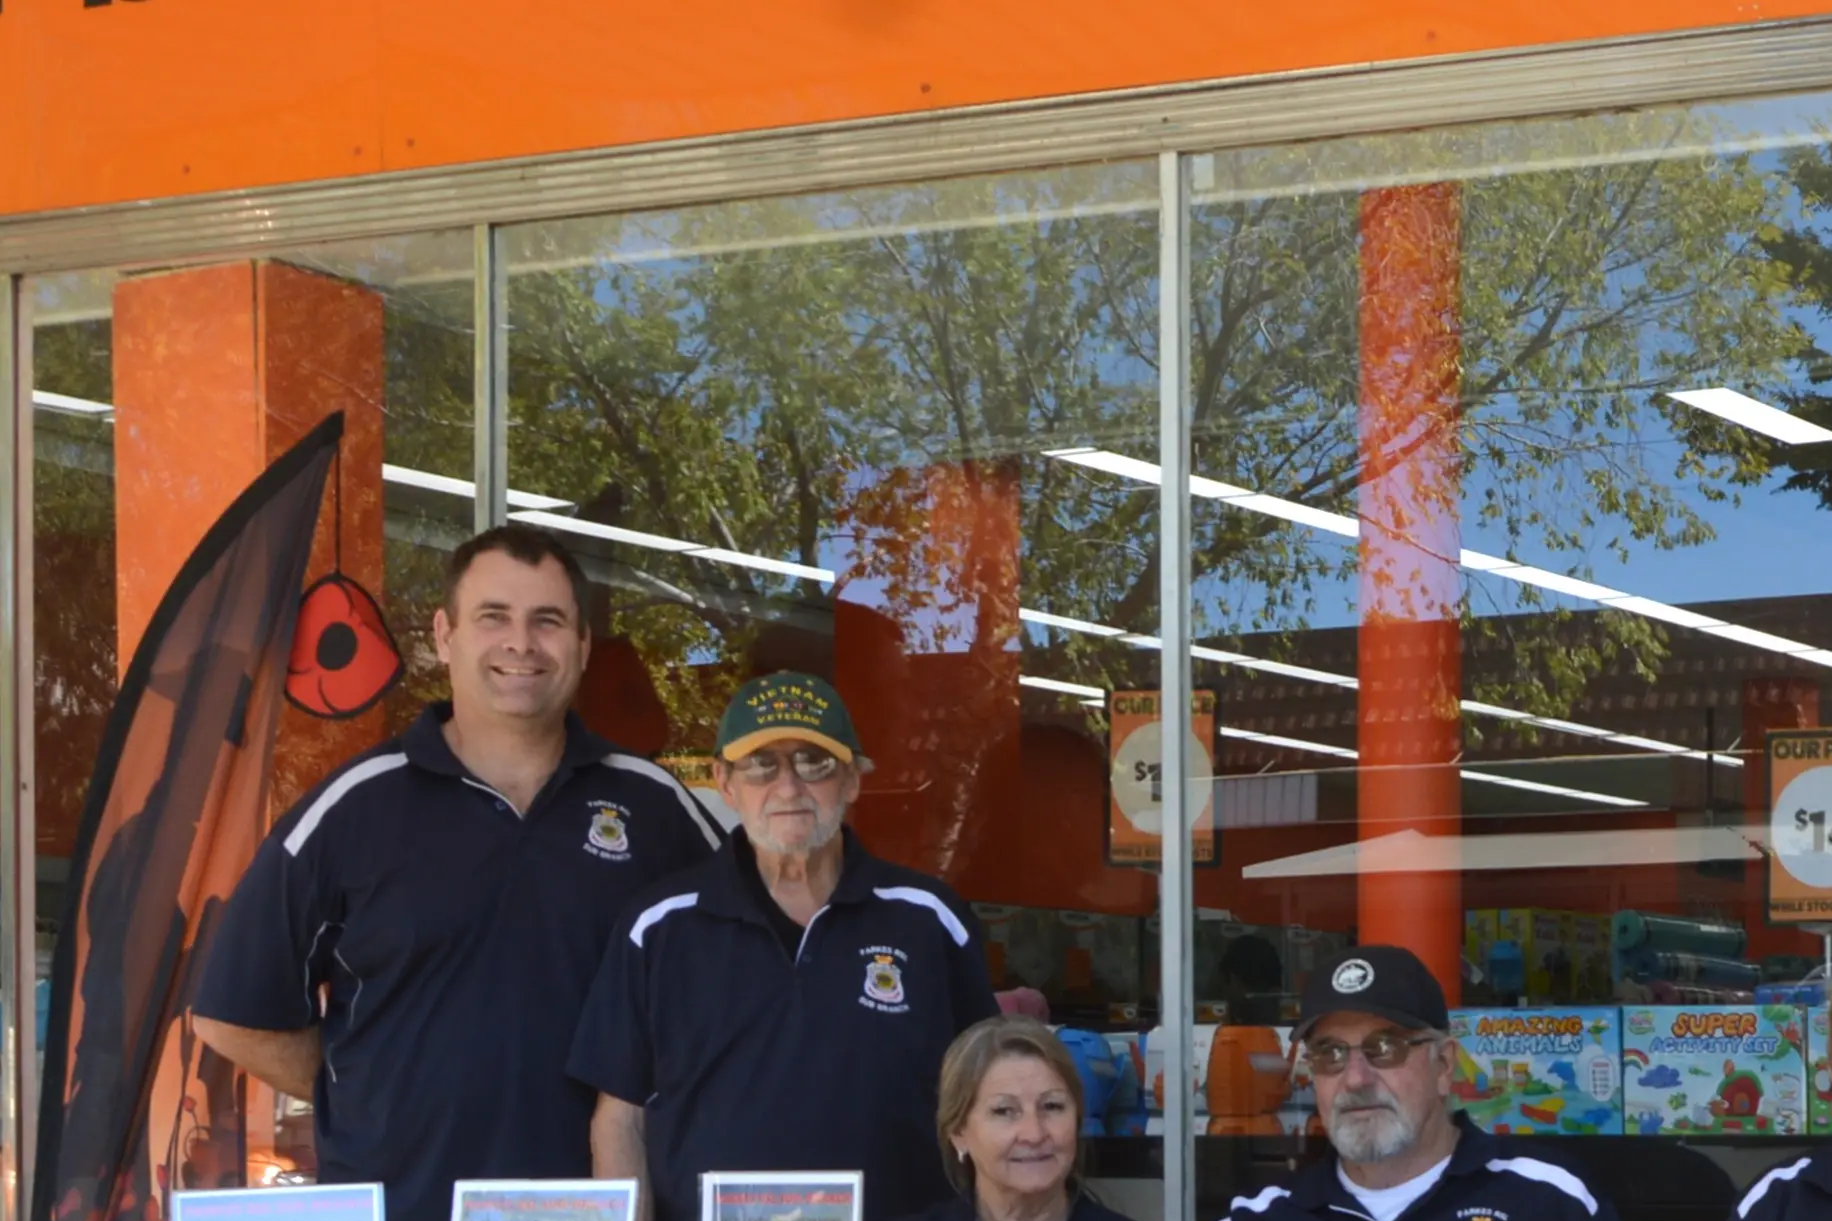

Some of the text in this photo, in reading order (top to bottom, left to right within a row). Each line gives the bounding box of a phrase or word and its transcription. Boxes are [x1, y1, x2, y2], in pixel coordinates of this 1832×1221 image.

[746, 685, 829, 710] VIETNAM
[757, 711, 821, 726] VETERAN
[1774, 739, 1821, 760] OUR
[1475, 1015, 1583, 1036] AMAZING
[1671, 1012, 1757, 1037] SUPER
[1475, 1035, 1583, 1055] ANIMALS
[1650, 1036, 1778, 1054] ACTIVITY SET
